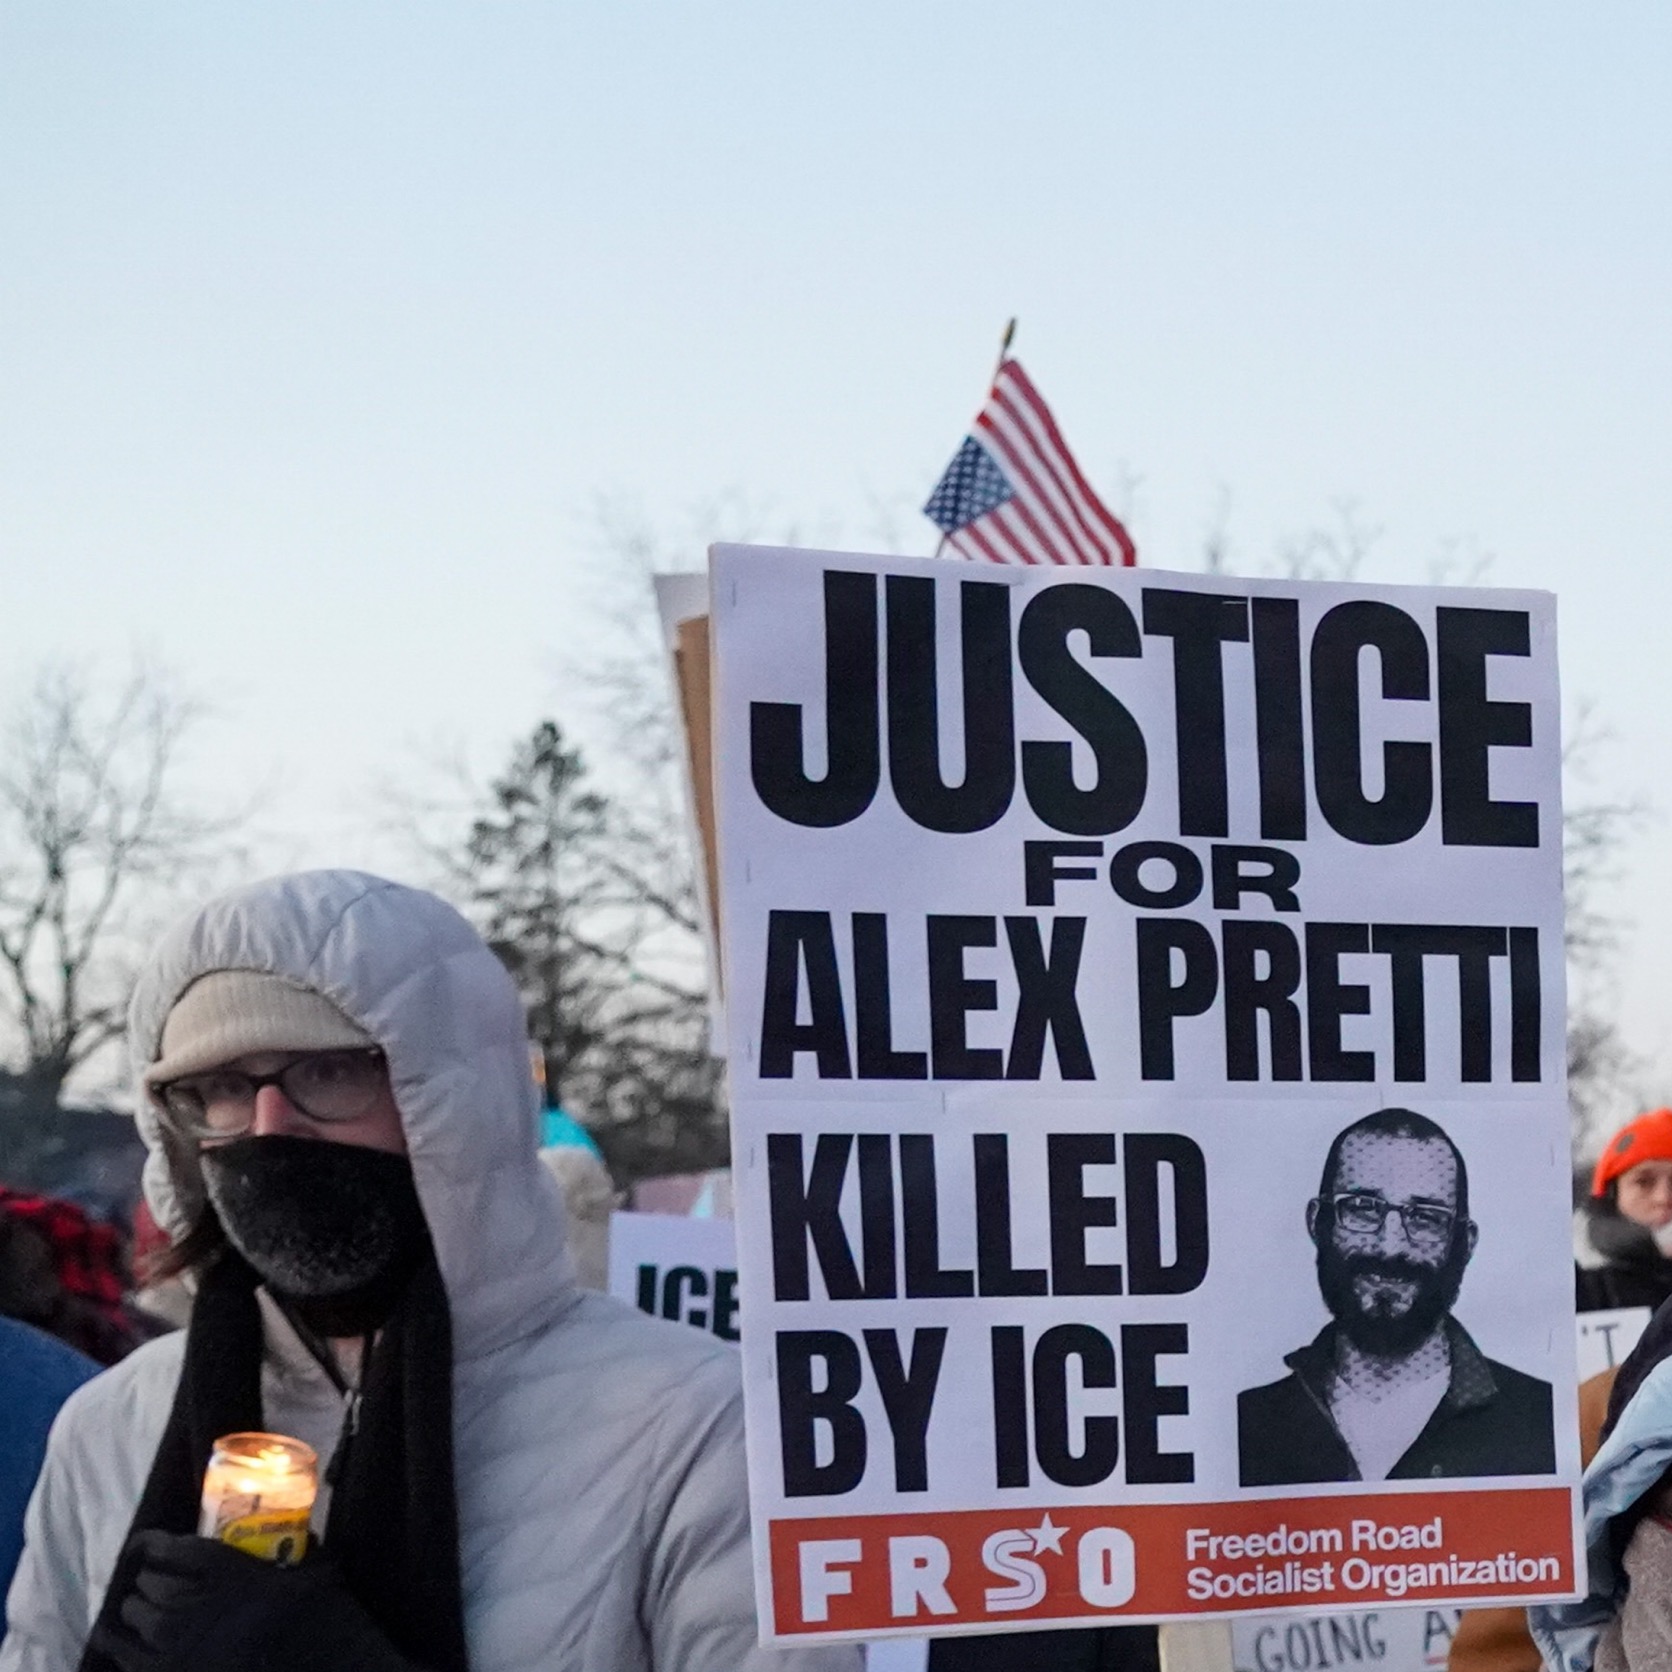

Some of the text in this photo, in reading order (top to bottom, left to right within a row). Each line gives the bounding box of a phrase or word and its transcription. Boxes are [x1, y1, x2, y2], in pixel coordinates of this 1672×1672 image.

[750, 569, 1540, 849] JUSTICE
[1023, 840, 1301, 913] FOR
[759, 909, 1541, 1083] ALEX PRETTI
[766, 1132, 1210, 1302] KILLED
[637, 1264, 742, 1342] ICE
[775, 1323, 1195, 1498] BY ICE
[1186, 1516, 1443, 1560] Freedom Road
[1187, 1552, 1560, 1600] Socialist Organization
[1423, 1608, 1463, 1651] A
